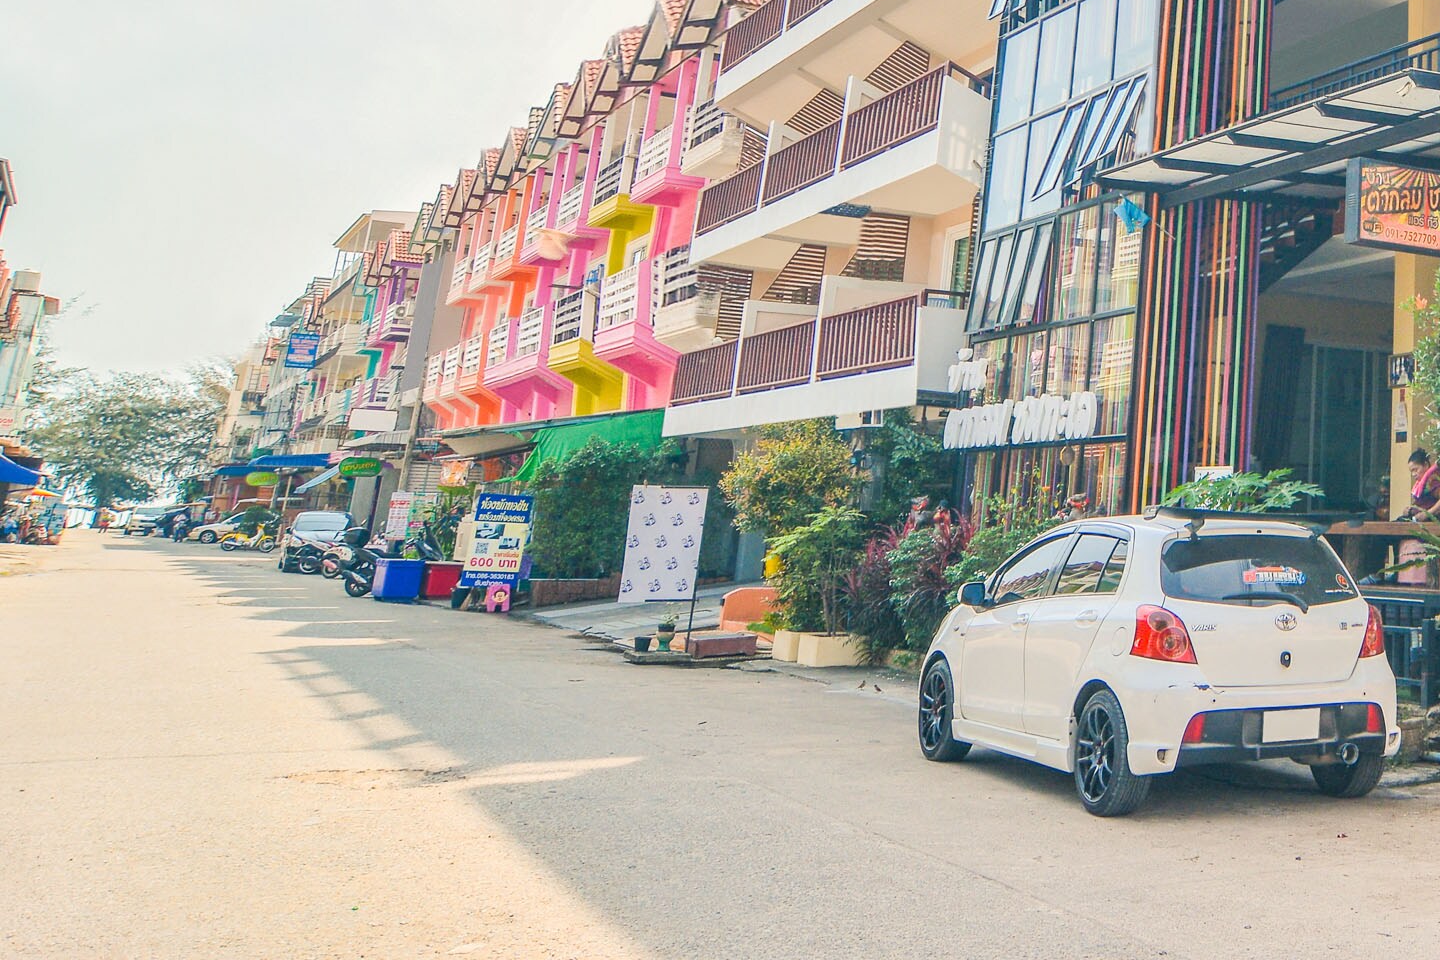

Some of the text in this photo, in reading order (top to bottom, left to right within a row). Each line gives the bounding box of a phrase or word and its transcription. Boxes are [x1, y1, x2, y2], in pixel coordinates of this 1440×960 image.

[1366, 168, 1391, 185] บ้าน
[1367, 188, 1422, 213] ตากลม
[470, 557, 517, 568] 600 บาท
